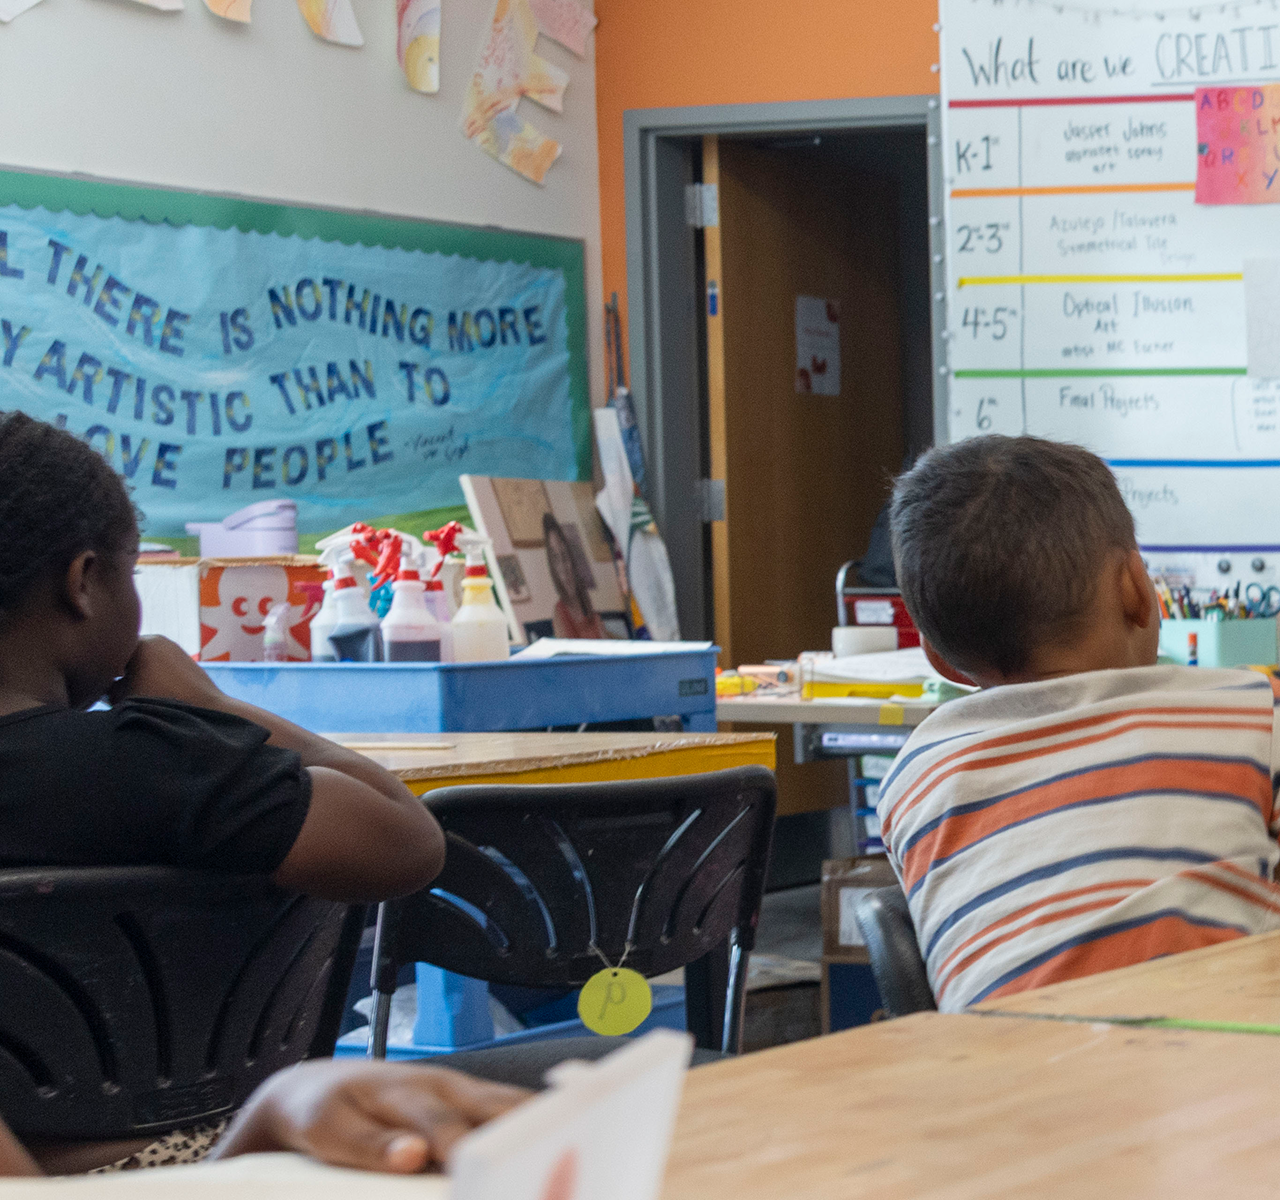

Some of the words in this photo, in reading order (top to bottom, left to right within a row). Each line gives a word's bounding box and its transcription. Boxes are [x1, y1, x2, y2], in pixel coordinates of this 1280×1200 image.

[962, 35, 1041, 86] What
[1057, 54, 1096, 84] are
[1104, 52, 1136, 78] we
[1201, 93, 1213, 110] A
[1216, 89, 1229, 111] B
[1233, 89, 1247, 113] C
[1252, 90, 1264, 110] D
[1063, 118, 1112, 143] Jasper
[1257, 118, 1268, 136] L
[1221, 147, 1235, 165] R
[1236, 170, 1248, 190] X
[1262, 168, 1279, 191] Y
[44, 238, 192, 357] THERE
[219, 306, 255, 355] IS
[267, 276, 433, 347] NOTHING
[446, 303, 547, 353] MORE
[1062, 291, 1119, 319] Optical
[33, 338, 253, 437] ARTISTIC
[269, 358, 376, 416] THAN
[398, 360, 452, 406] TO
[1058, 385, 1095, 410] Final
[1098, 382, 1161, 416] Projects
[55, 413, 183, 489] OVE
[222, 420, 394, 490] PEOPLE
